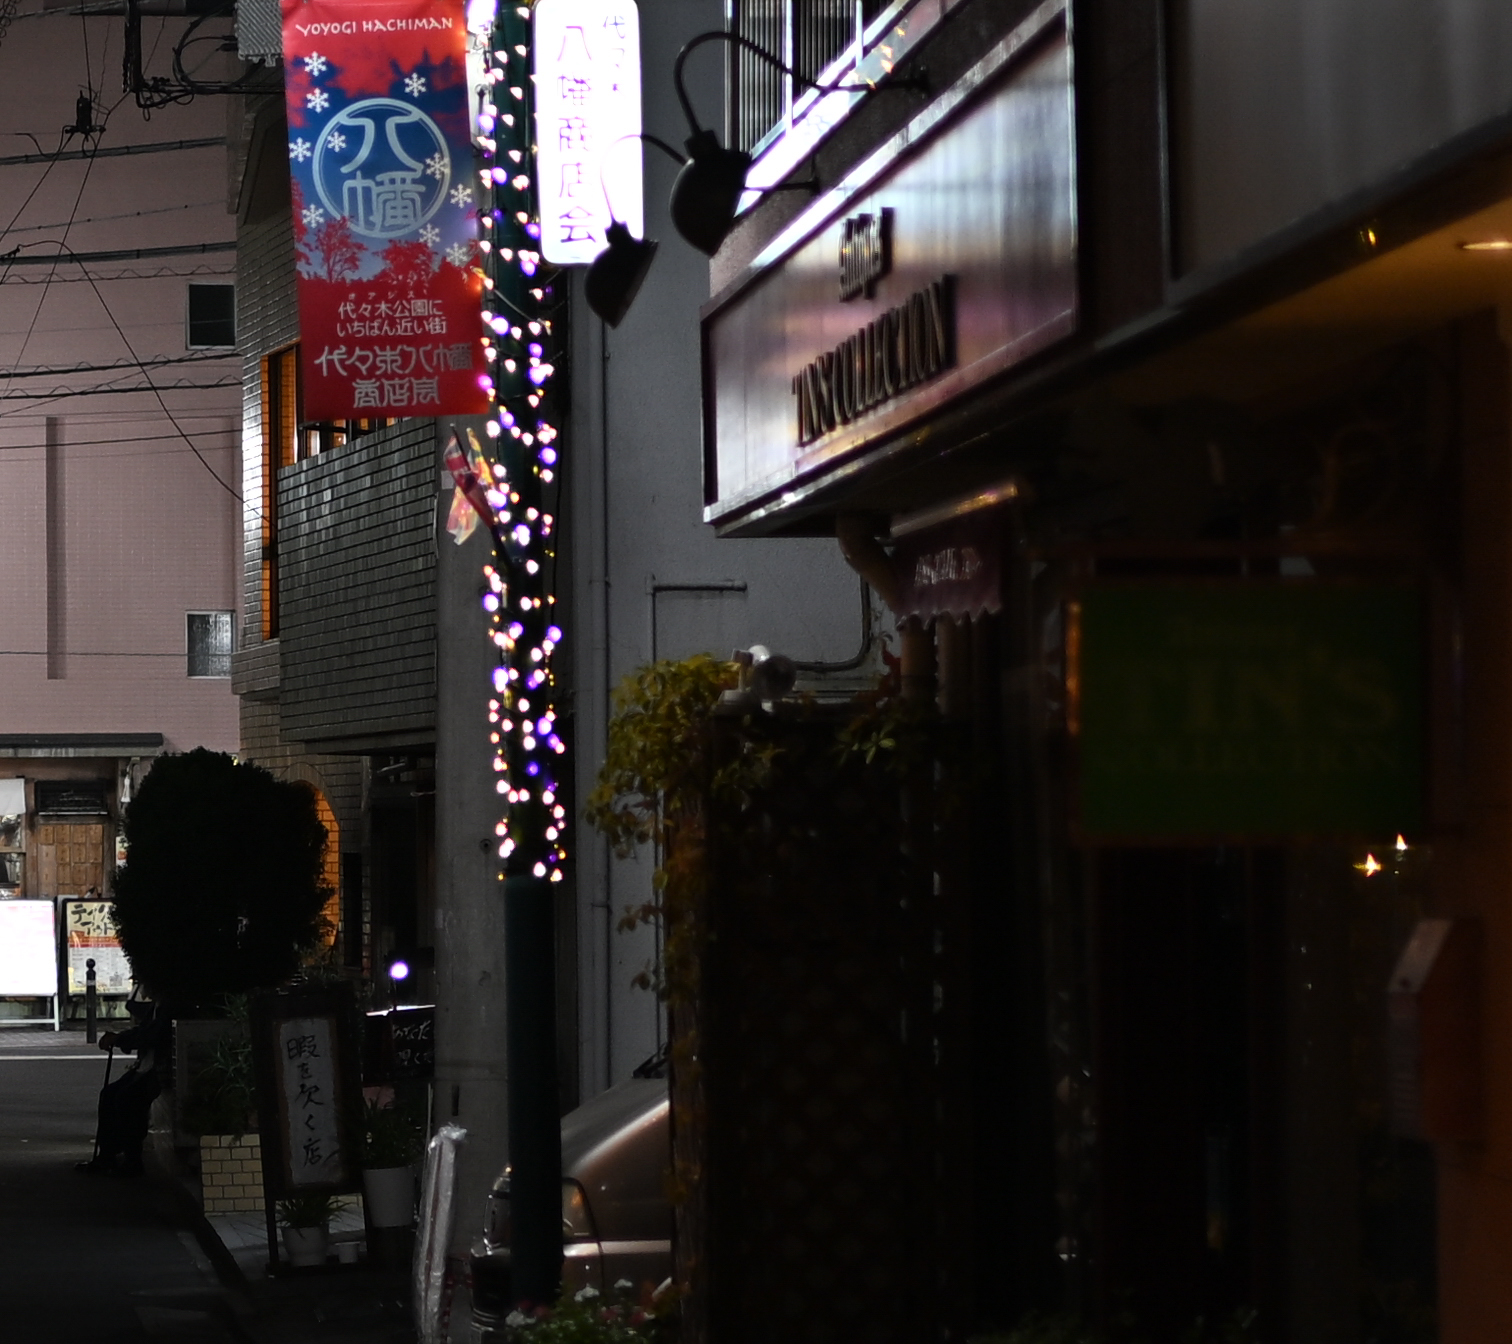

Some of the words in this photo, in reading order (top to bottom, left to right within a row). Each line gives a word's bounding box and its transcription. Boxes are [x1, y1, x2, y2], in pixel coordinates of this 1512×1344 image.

[295, 20, 357, 37] YOYOGI
[362, 16, 454, 33] HACHIMAN
[337, 299, 444, 320] 代々木公園に
[336, 316, 447, 338] いちばん近い街
[313, 341, 474, 377] 代々木八幡
